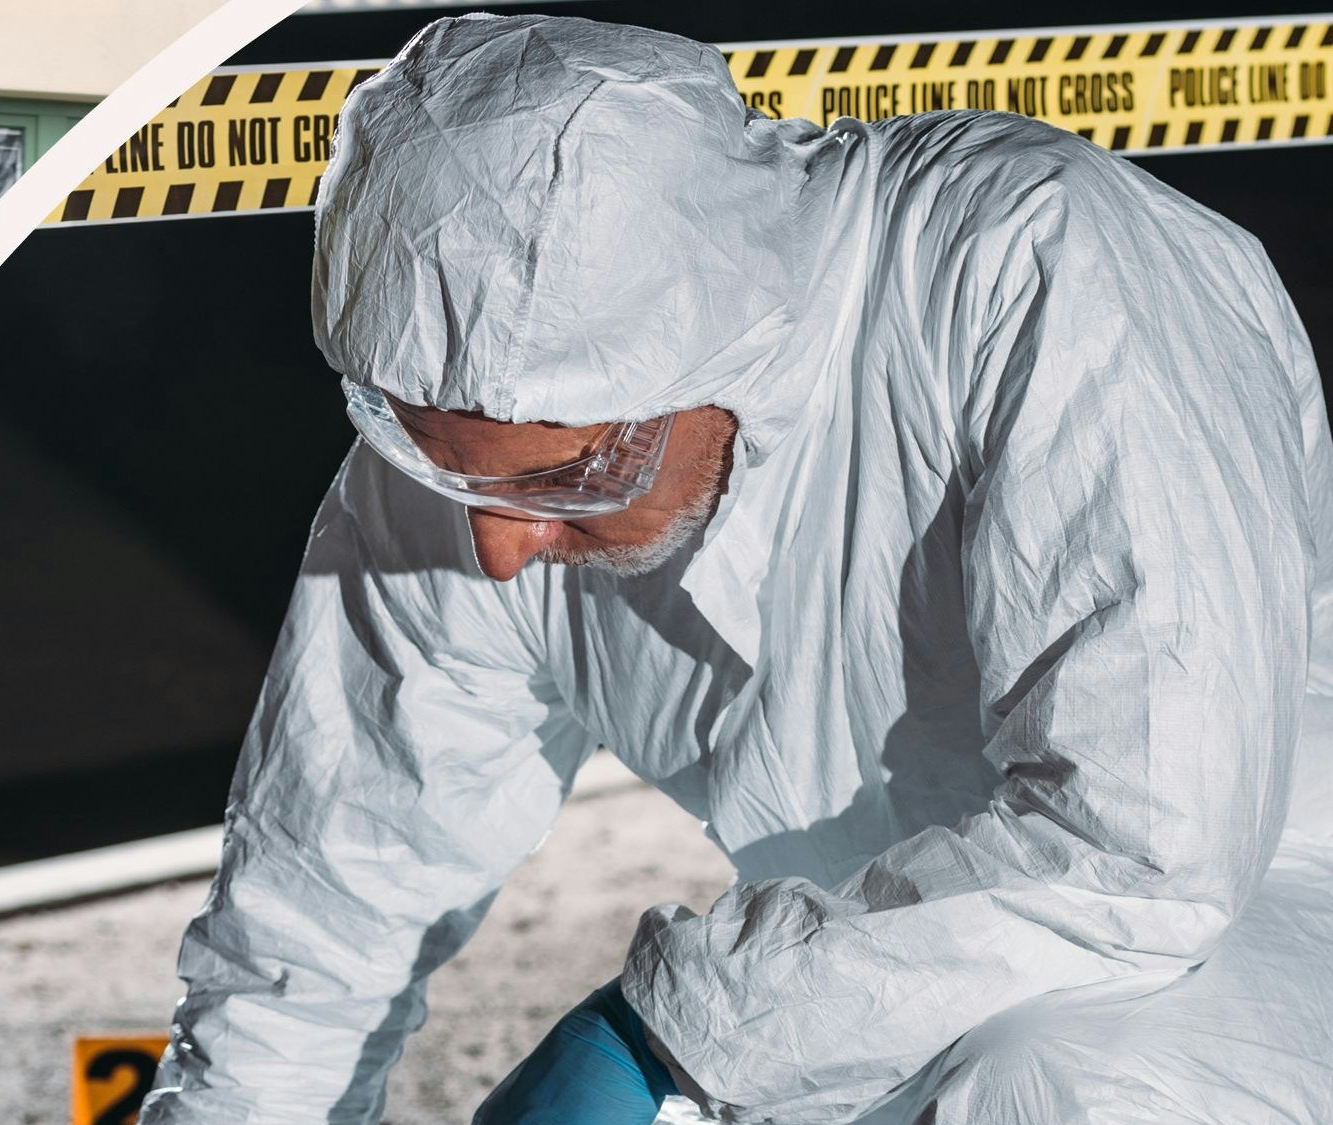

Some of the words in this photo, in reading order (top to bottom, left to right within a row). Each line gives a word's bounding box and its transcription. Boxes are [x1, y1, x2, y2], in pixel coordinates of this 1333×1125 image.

[1008, 76, 1048, 117] NOT
[1059, 71, 1134, 115] CROSS
[1169, 64, 1238, 107] POLICE
[1248, 63, 1289, 104] LINE
[1299, 60, 1325, 100] DO
[176, 119, 215, 169] DO
[229, 117, 282, 167] NOT
